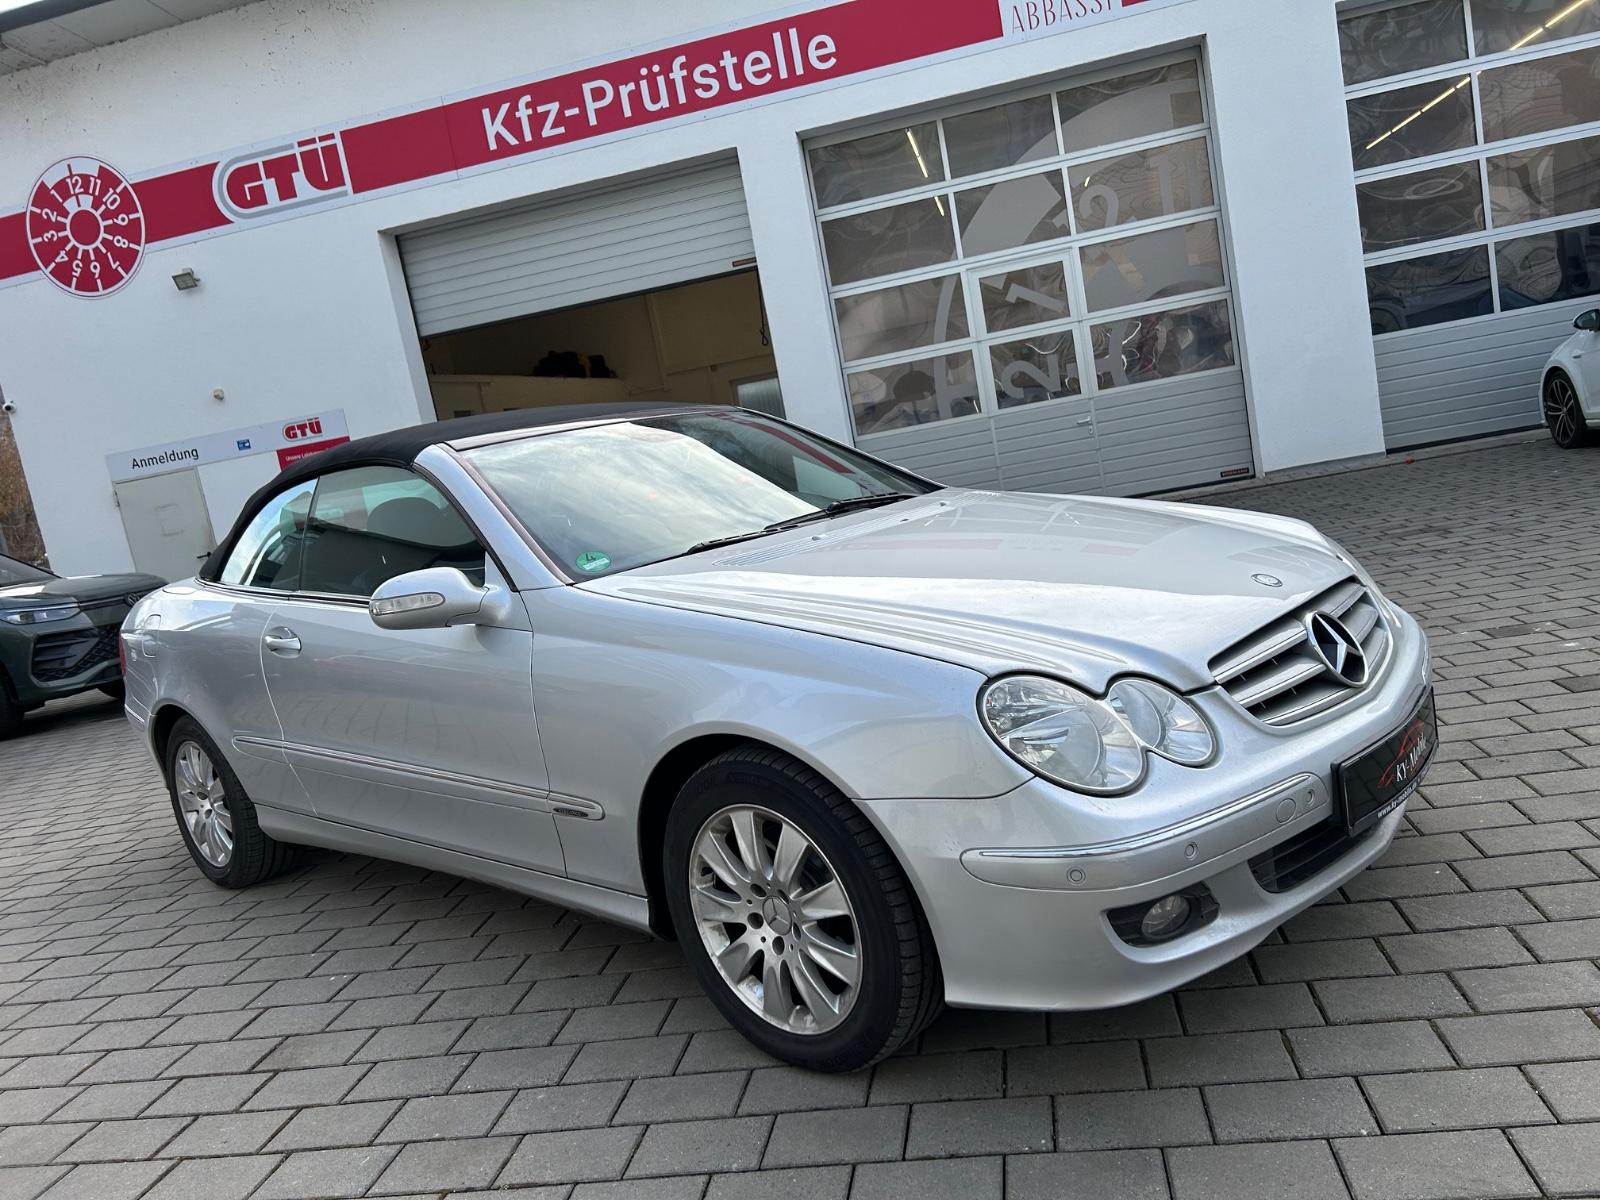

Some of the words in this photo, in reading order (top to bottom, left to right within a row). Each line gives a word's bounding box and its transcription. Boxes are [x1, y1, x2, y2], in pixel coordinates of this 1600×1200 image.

[481, 27, 837, 151] Kfz-Prüfstelle
[226, 133, 347, 209] GTÜ
[66, 176, 84, 195] 12
[89, 177, 101, 196] 11
[50, 189, 63, 203] 1
[102, 187, 121, 210] 10
[42, 208, 57, 222] 2
[113, 213, 129, 226] 9
[43, 230, 58, 242] 3
[113, 235, 129, 248] 8
[55, 250, 69, 263] 4
[107, 252, 120, 270] 7
[71, 260, 83, 277] 5
[90, 261, 100, 278] 6
[284, 417, 323, 440] GTÜ
[132, 448, 200, 470] Anmeldung
